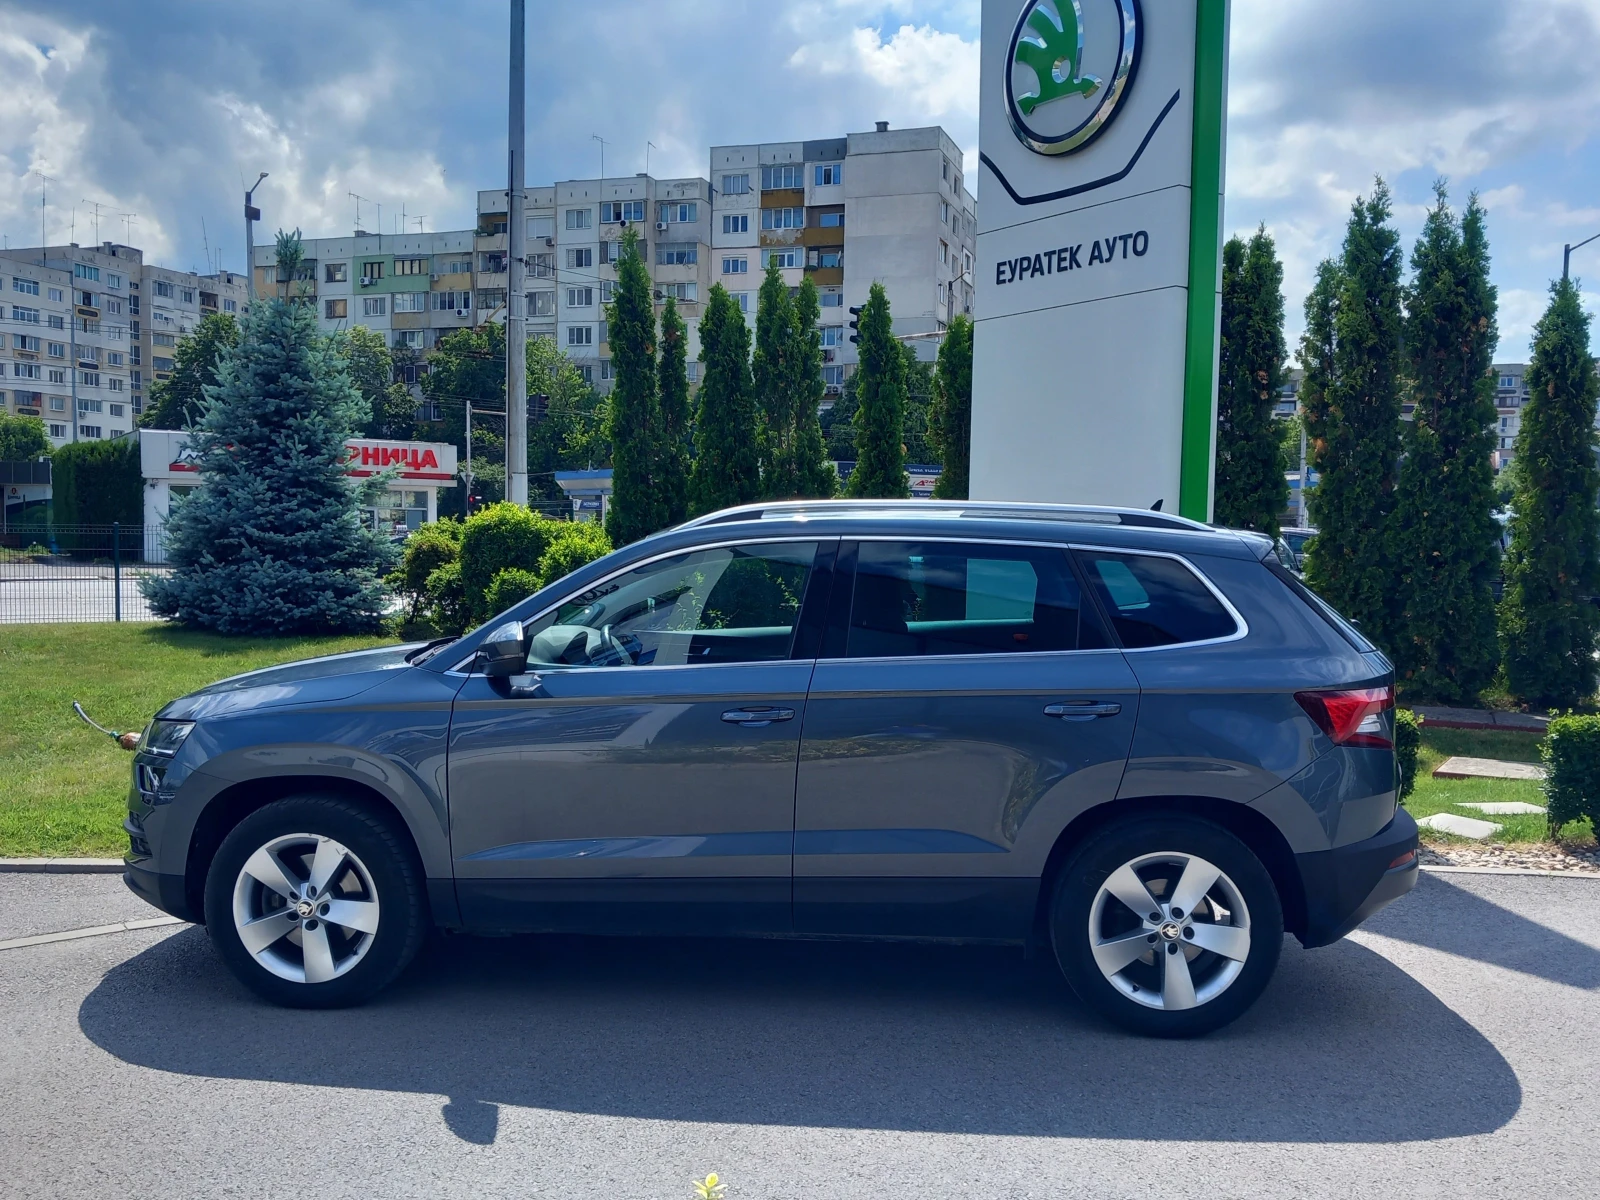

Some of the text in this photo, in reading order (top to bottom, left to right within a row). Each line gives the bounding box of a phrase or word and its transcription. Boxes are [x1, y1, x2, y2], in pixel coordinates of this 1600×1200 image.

[996, 230, 1149, 285] ЕУРАТЕК АУТО
[337, 445, 439, 471] РНИЦА
